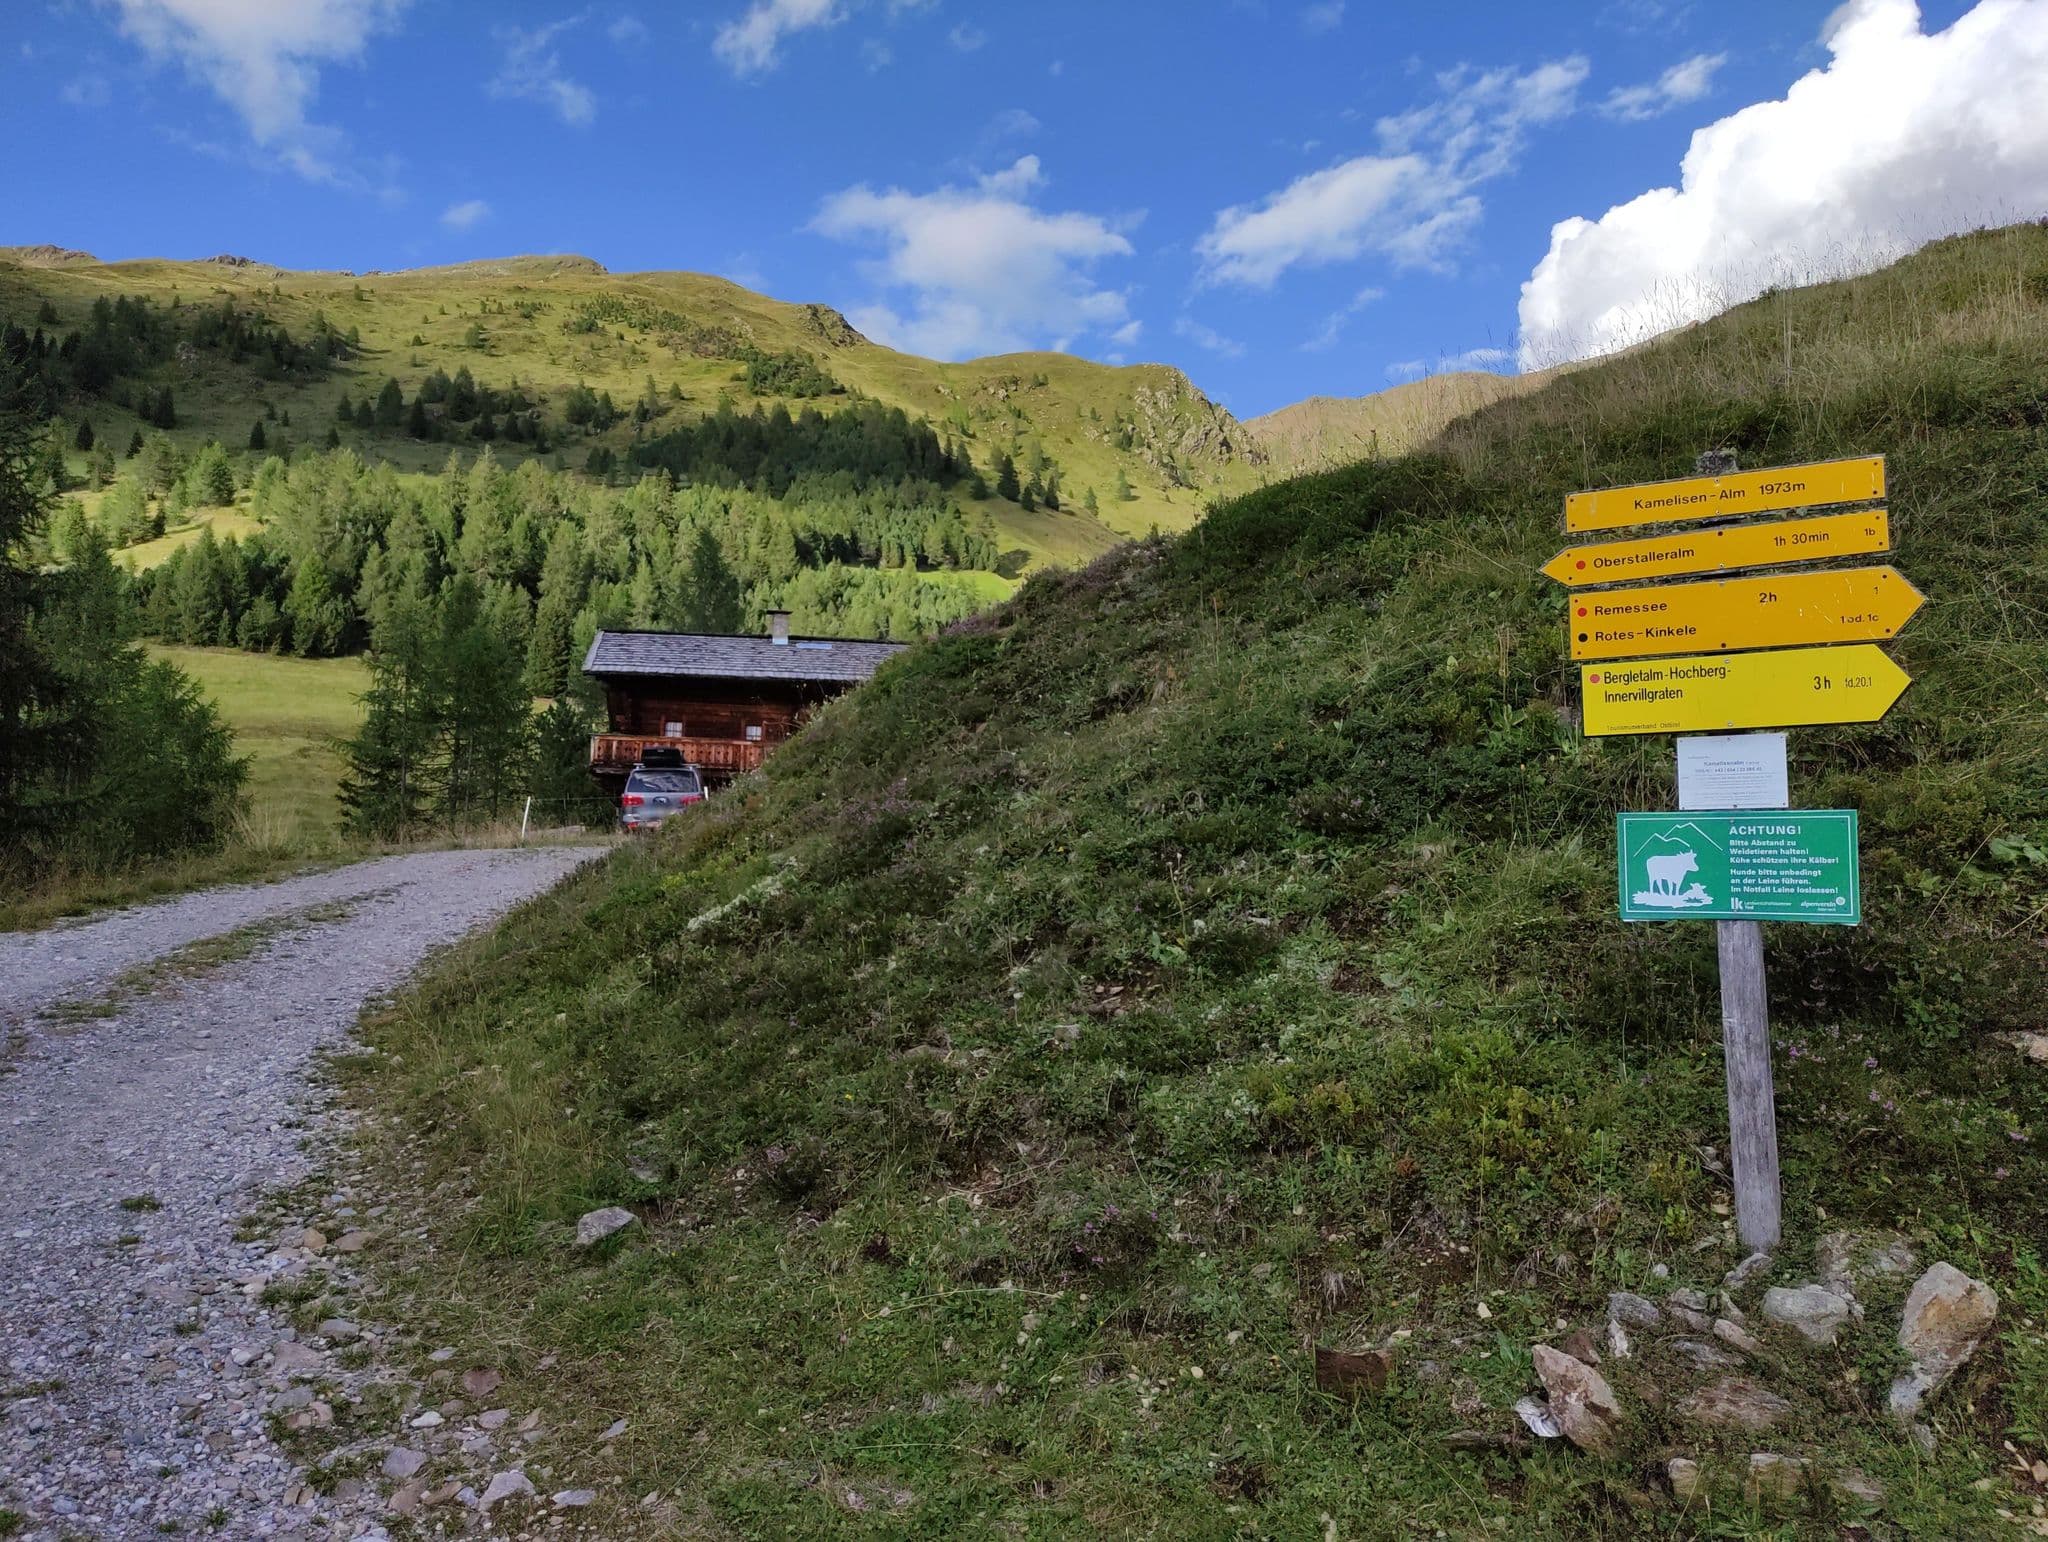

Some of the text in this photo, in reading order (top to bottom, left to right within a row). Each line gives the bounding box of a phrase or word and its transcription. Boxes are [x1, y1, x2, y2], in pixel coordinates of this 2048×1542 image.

[1634, 481, 1806, 510] Kamelisen-Alm 1973m
[1593, 527, 1876, 569] Oberstalleralm 1h 30min 1b
[1594, 602, 1668, 617] Remessee
[1595, 625, 1697, 642] Rotes-Kinkele
[1867, 613, 1880, 622] 1c
[1604, 687, 1684, 703] Innervillgraten
[1729, 825, 1801, 835] ACHTUNG!
[1796, 886, 1839, 894] loslassen!
